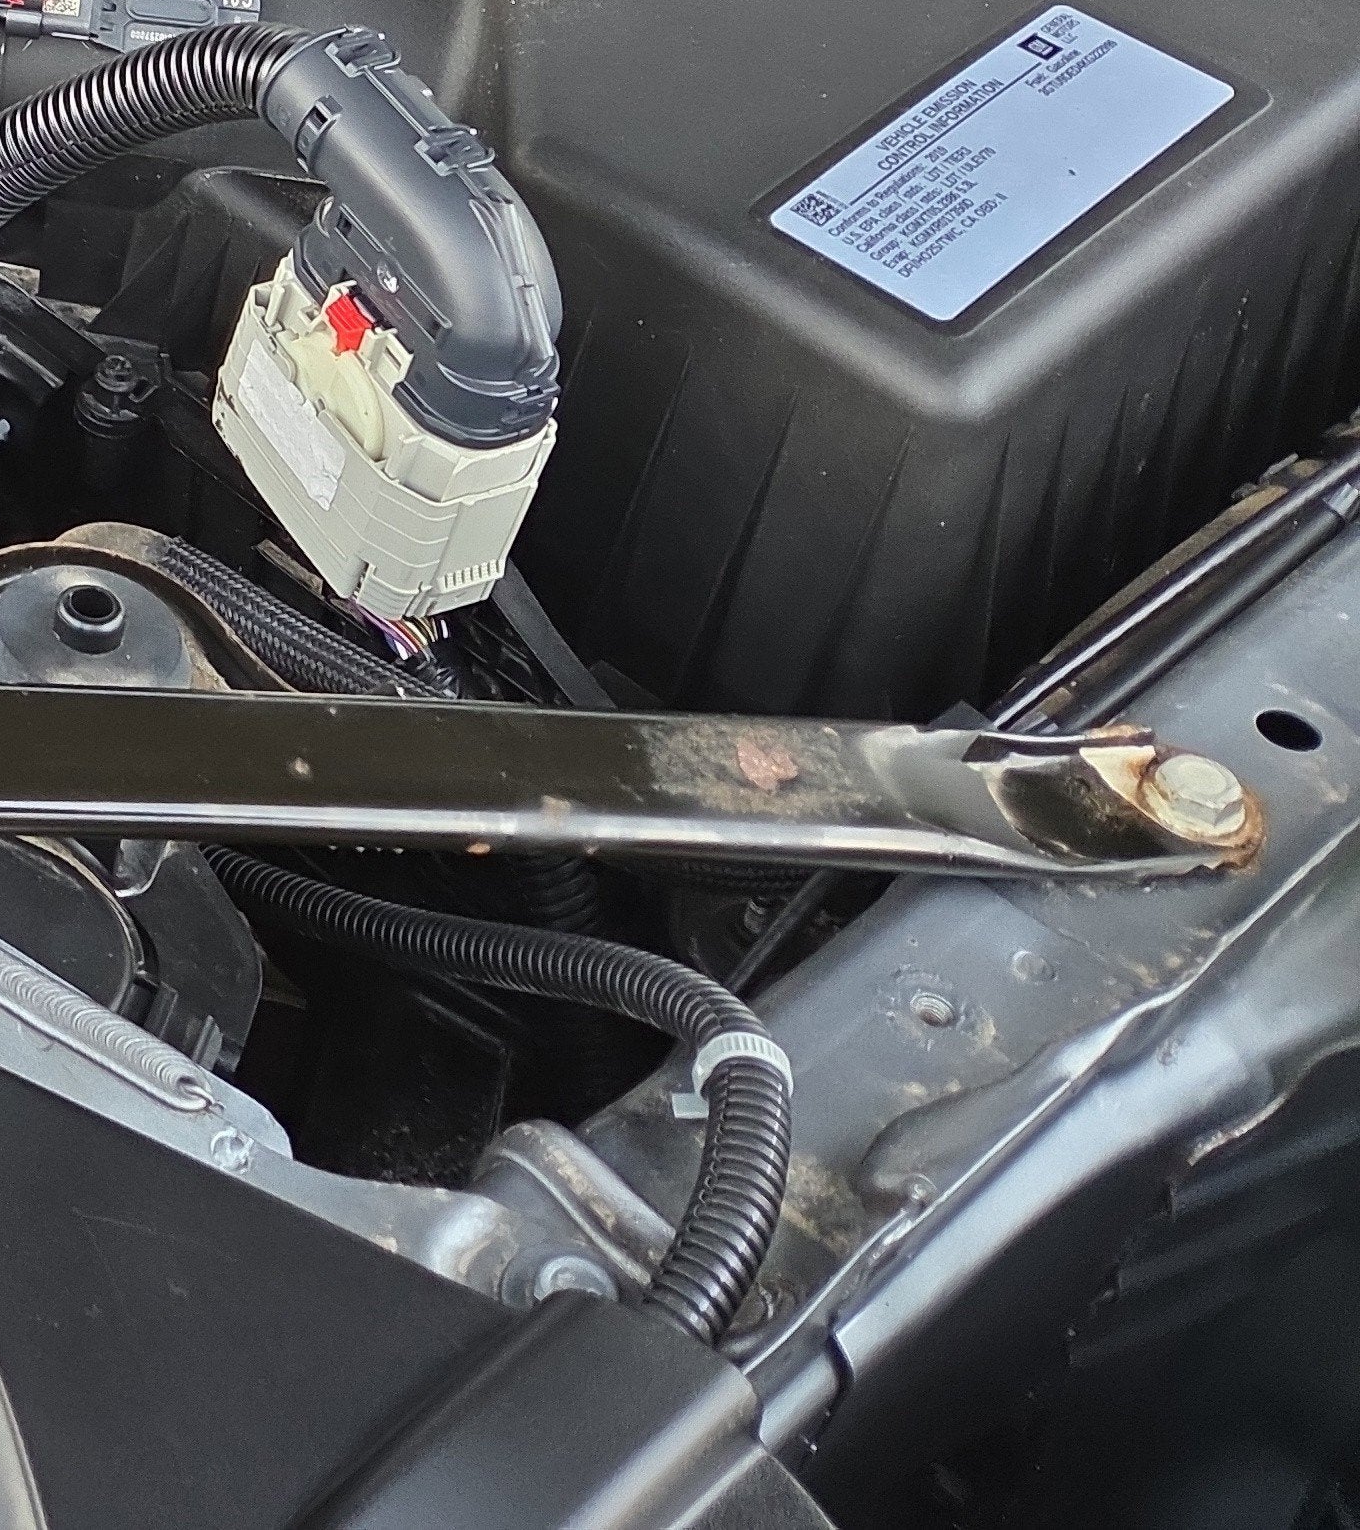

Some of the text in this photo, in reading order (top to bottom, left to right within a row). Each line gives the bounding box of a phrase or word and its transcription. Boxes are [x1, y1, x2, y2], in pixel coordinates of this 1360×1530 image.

[875, 79, 977, 151] VEHICLE EMISSION
[877, 78, 1004, 171] CONTROL INFORMATION
[828, 206, 871, 237] Conforms
[878, 201, 902, 218] class
[856, 222, 899, 253] California
[895, 206, 919, 224] class
[870, 237, 903, 263] Group:
